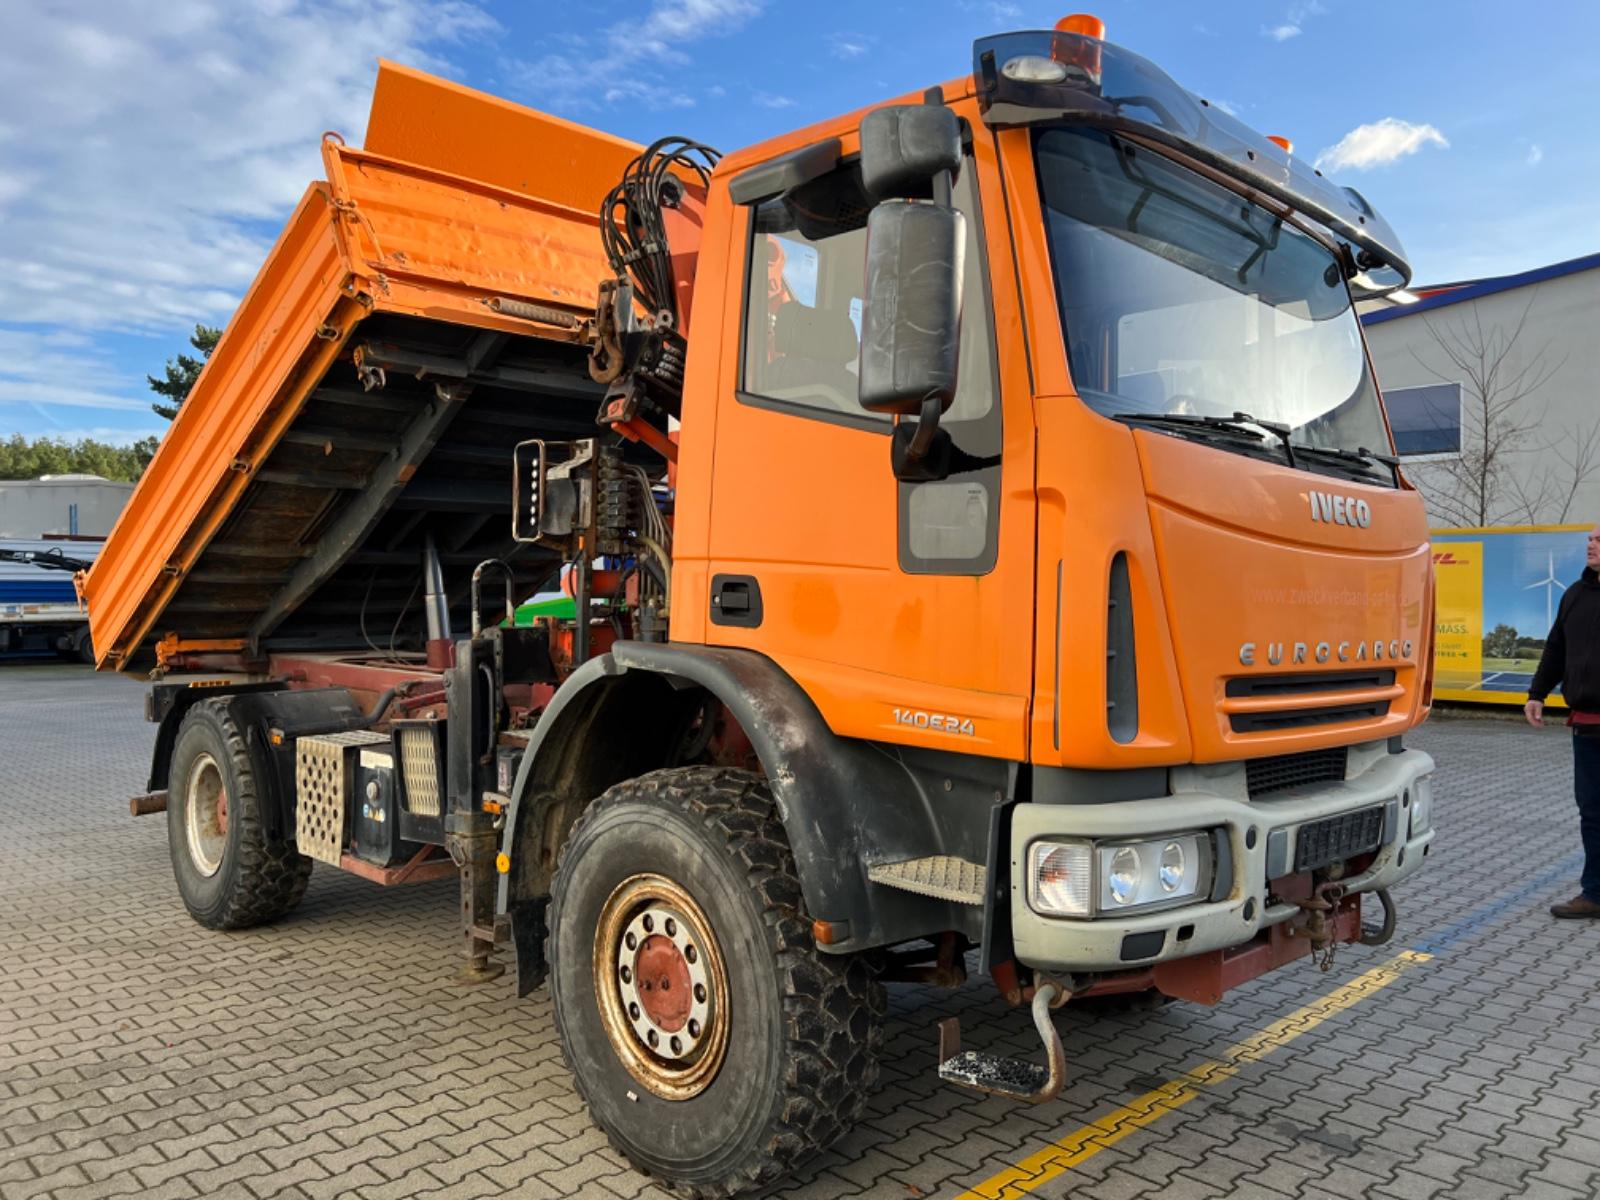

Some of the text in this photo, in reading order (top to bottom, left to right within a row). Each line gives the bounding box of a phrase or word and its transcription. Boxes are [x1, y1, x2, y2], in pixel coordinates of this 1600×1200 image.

[1309, 490, 1371, 528] IVECO
[1239, 640, 1412, 666] EUROCARGO
[893, 708, 975, 737] 140E24
